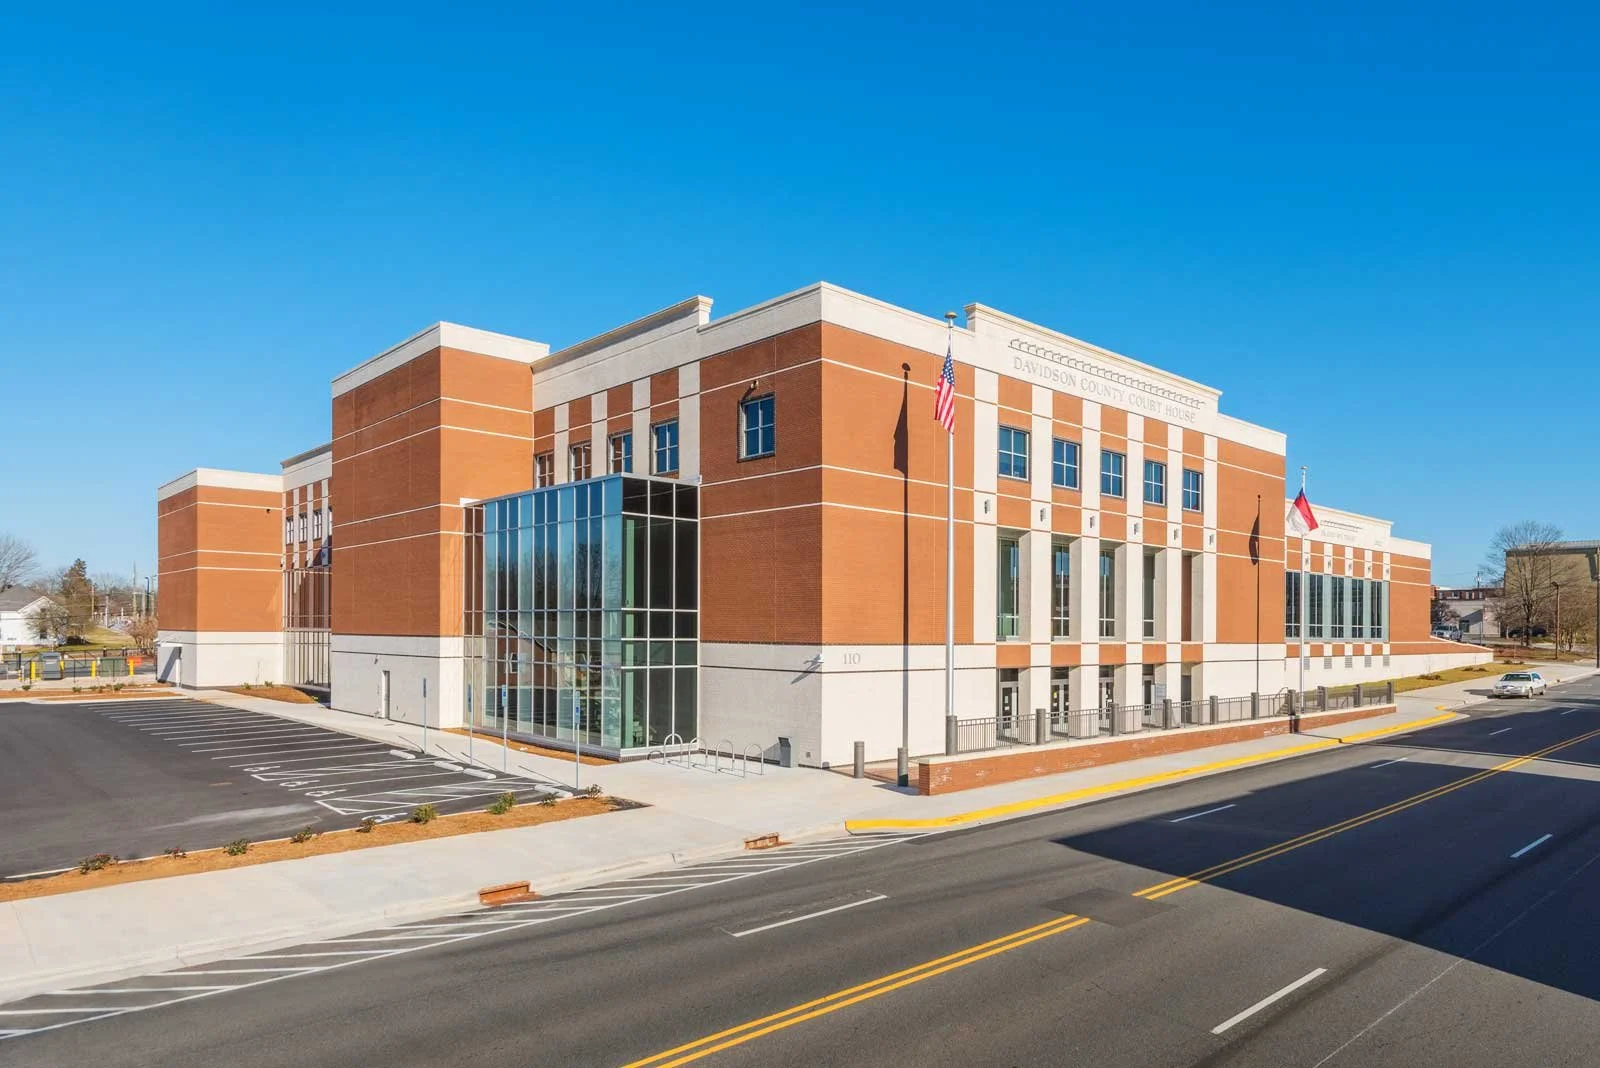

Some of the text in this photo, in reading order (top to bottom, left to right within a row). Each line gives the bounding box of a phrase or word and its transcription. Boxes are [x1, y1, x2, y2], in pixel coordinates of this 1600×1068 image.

[1013, 356, 1196, 424] DAVIDSON COUNTY COURT HOUSE
[843, 652, 861, 665] 110
